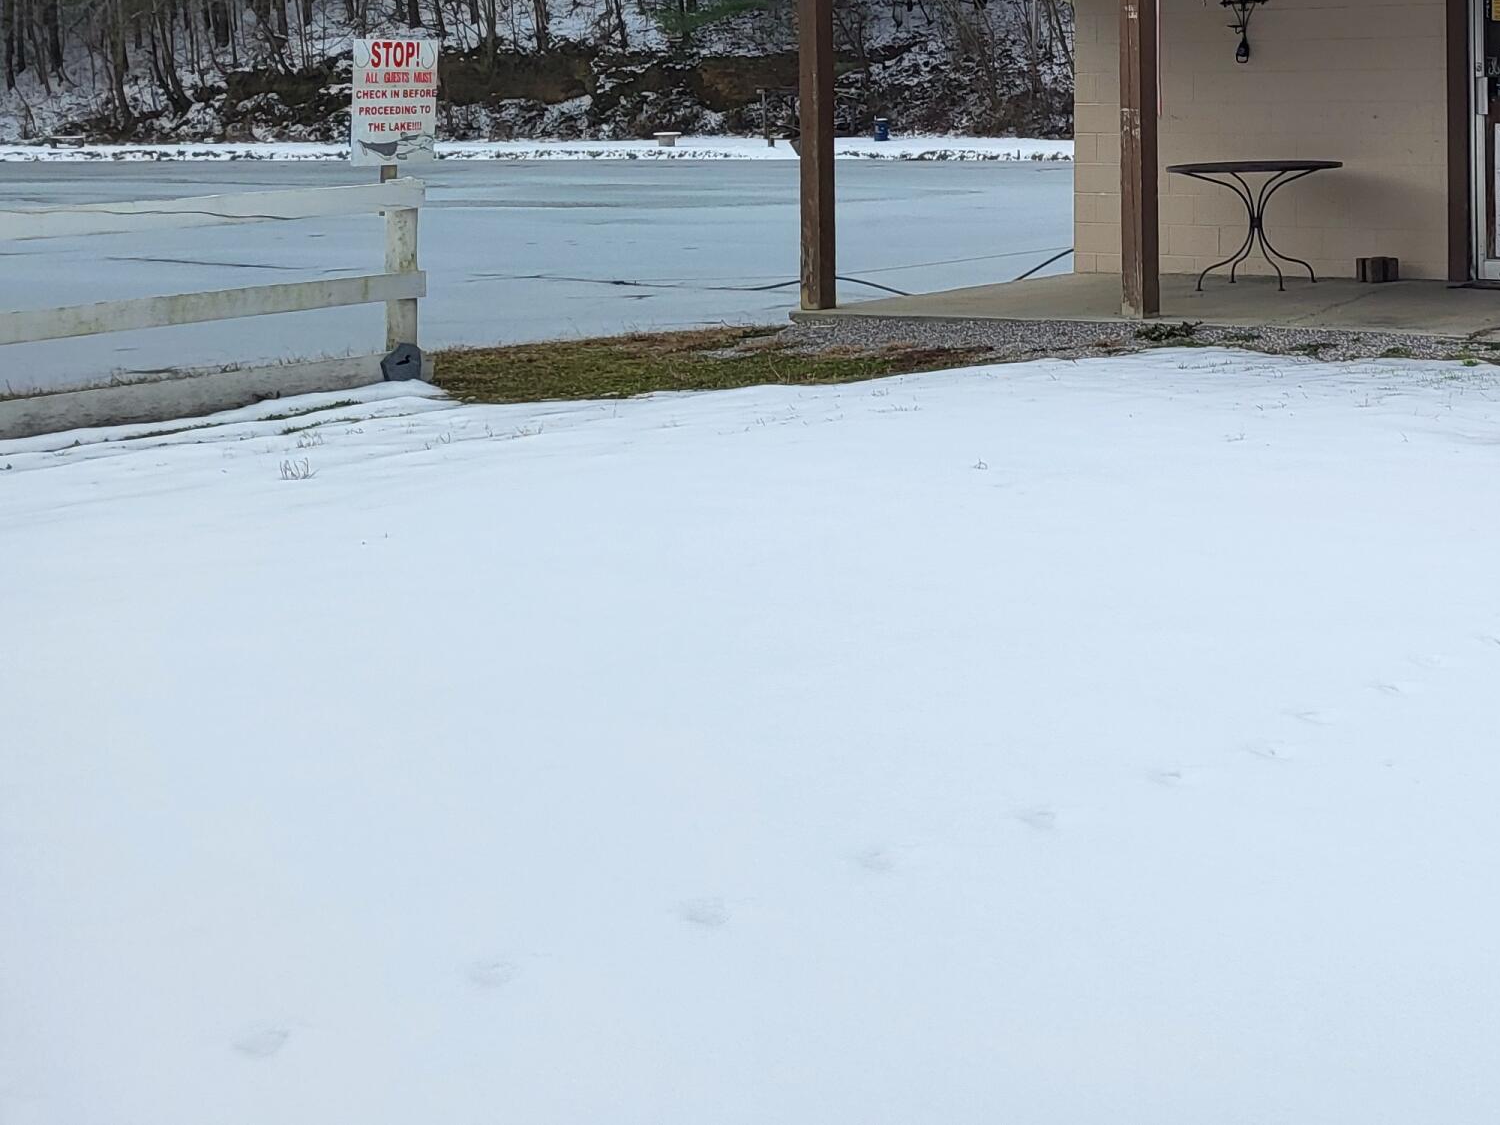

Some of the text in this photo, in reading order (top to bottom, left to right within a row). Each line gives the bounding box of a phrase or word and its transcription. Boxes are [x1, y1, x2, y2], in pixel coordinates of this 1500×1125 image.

[370, 41, 420, 68] STOP!
[365, 72, 432, 84] ALL GUESTS MUST
[356, 88, 437, 100] CHECK IN BEFORE
[358, 105, 431, 116] PROCEEDING TO
[368, 122, 386, 133] THE
